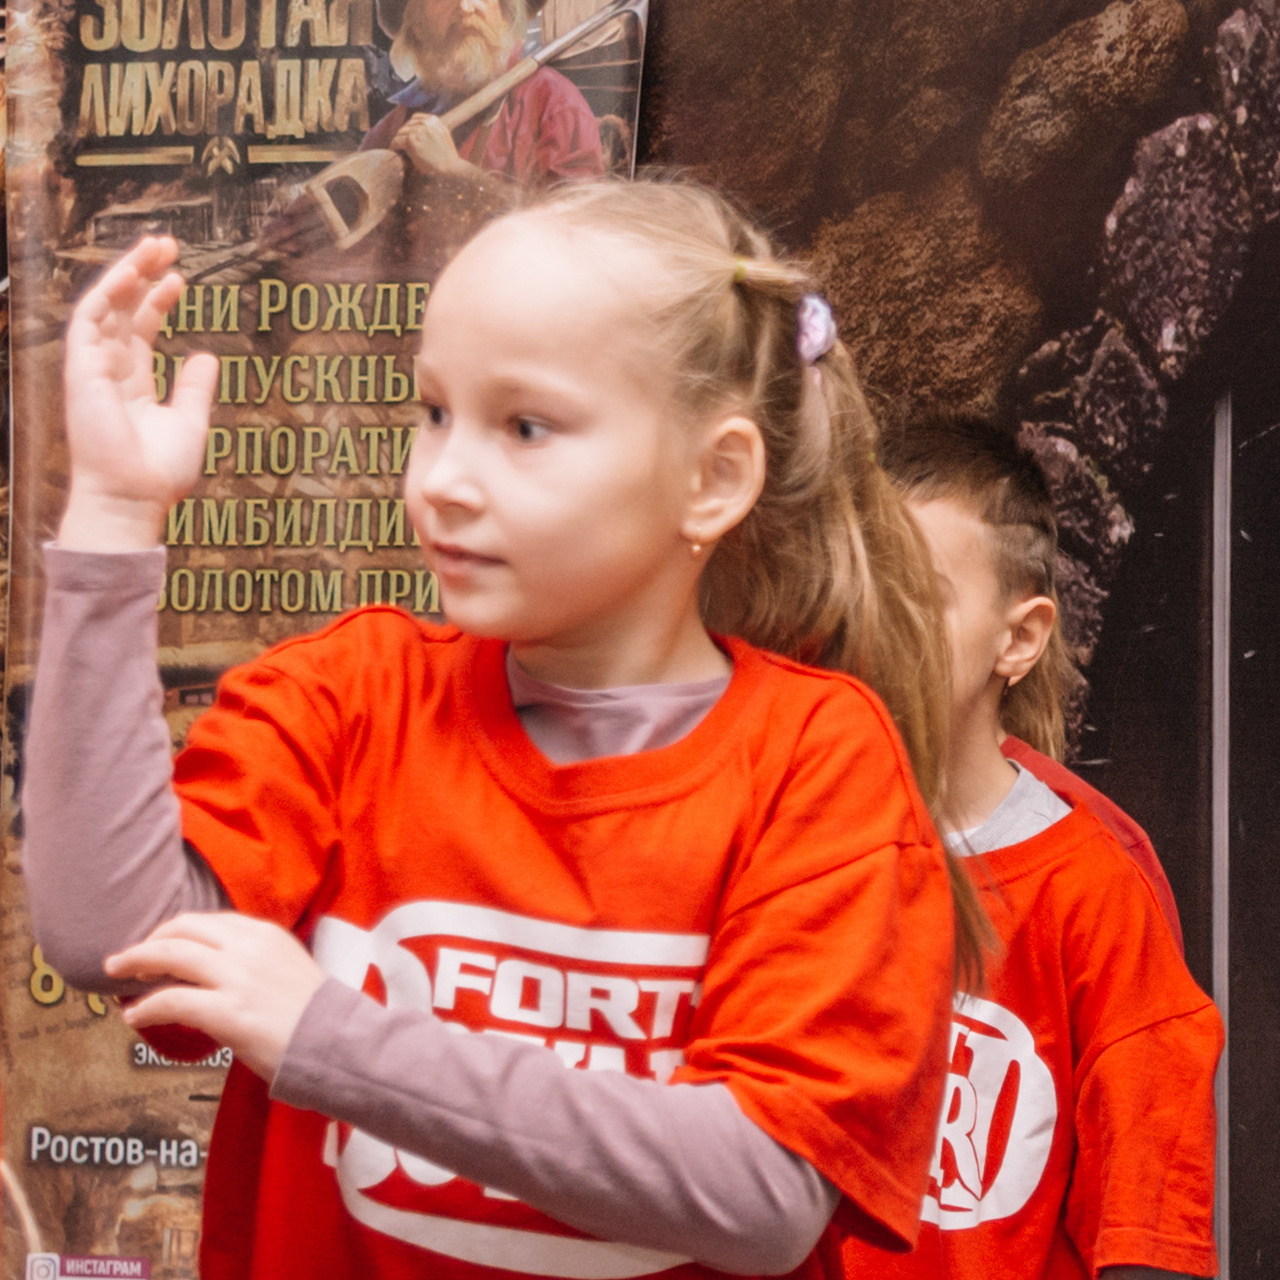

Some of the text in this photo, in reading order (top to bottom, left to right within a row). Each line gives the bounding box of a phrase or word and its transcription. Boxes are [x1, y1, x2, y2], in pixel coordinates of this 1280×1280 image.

[76, 57, 372, 140] ЛИХОРАДКА
[432, 946, 697, 1041] FORT
[65, 1259, 142, 1276] ИНСТАГРАМ
